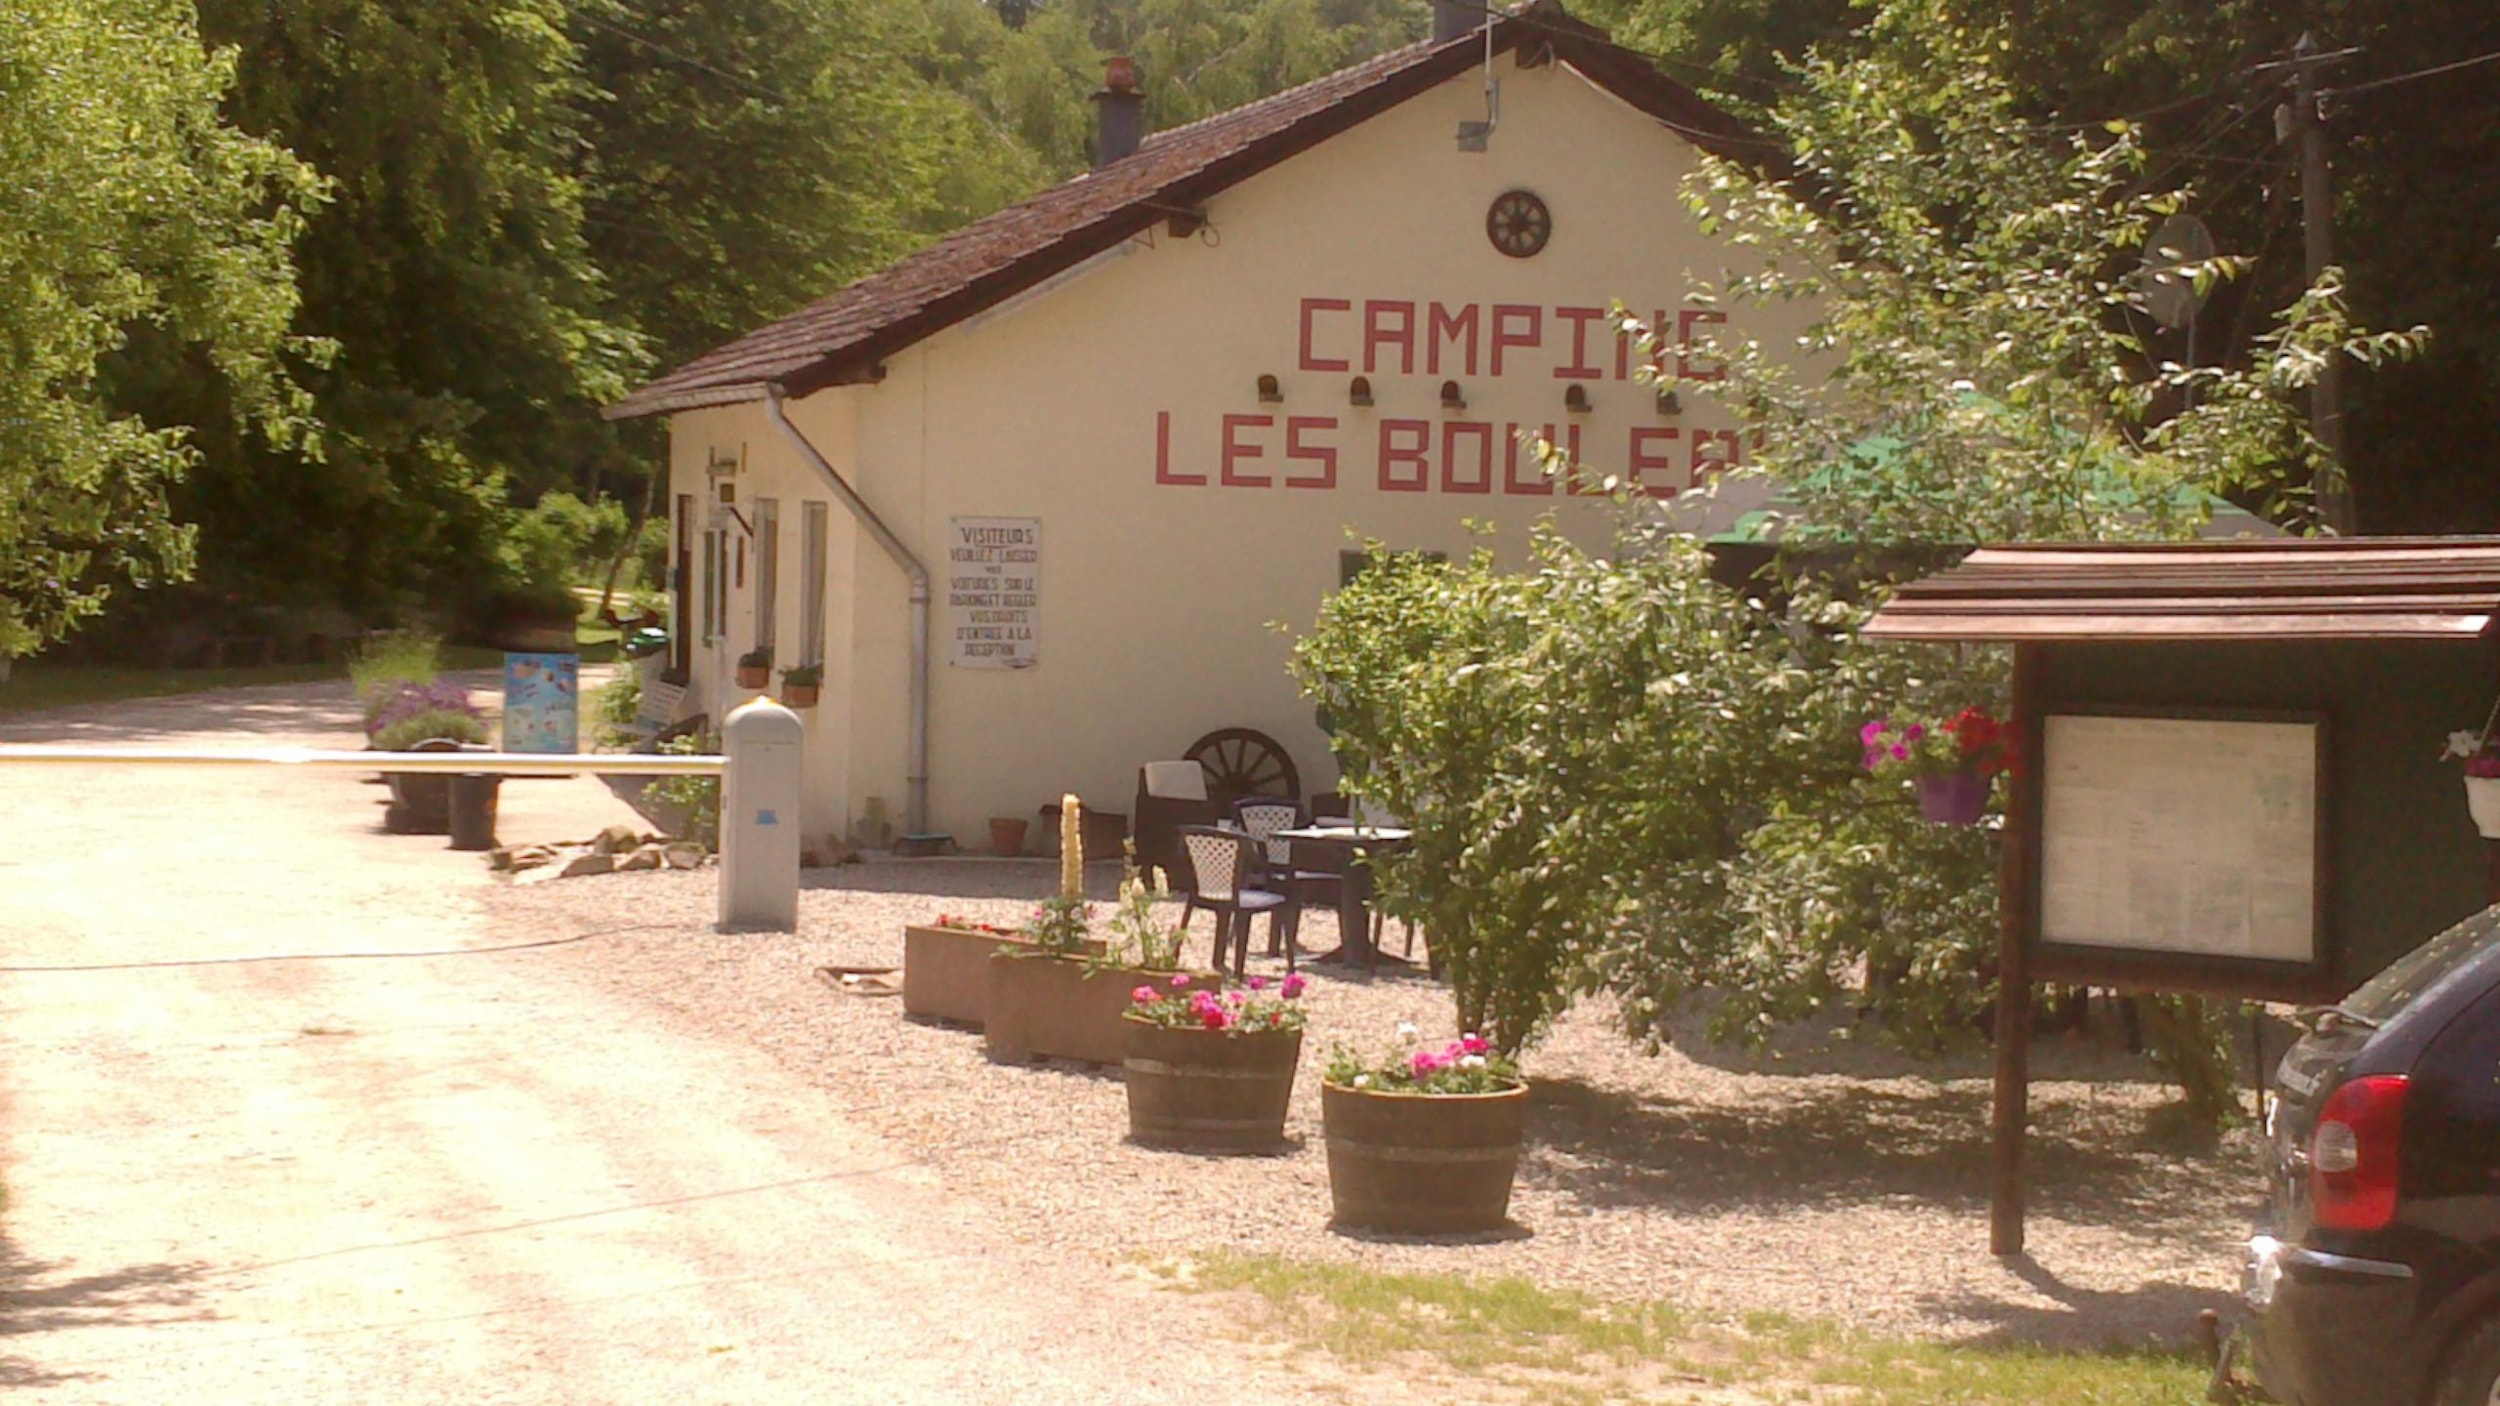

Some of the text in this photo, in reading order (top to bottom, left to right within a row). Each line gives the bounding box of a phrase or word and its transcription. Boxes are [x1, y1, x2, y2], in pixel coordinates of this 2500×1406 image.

[1299, 298, 1728, 381] CAMPING
[1155, 411, 1339, 489] LES
[961, 527, 1033, 544] VISITEURS
[1018, 627, 1032, 641] LA
